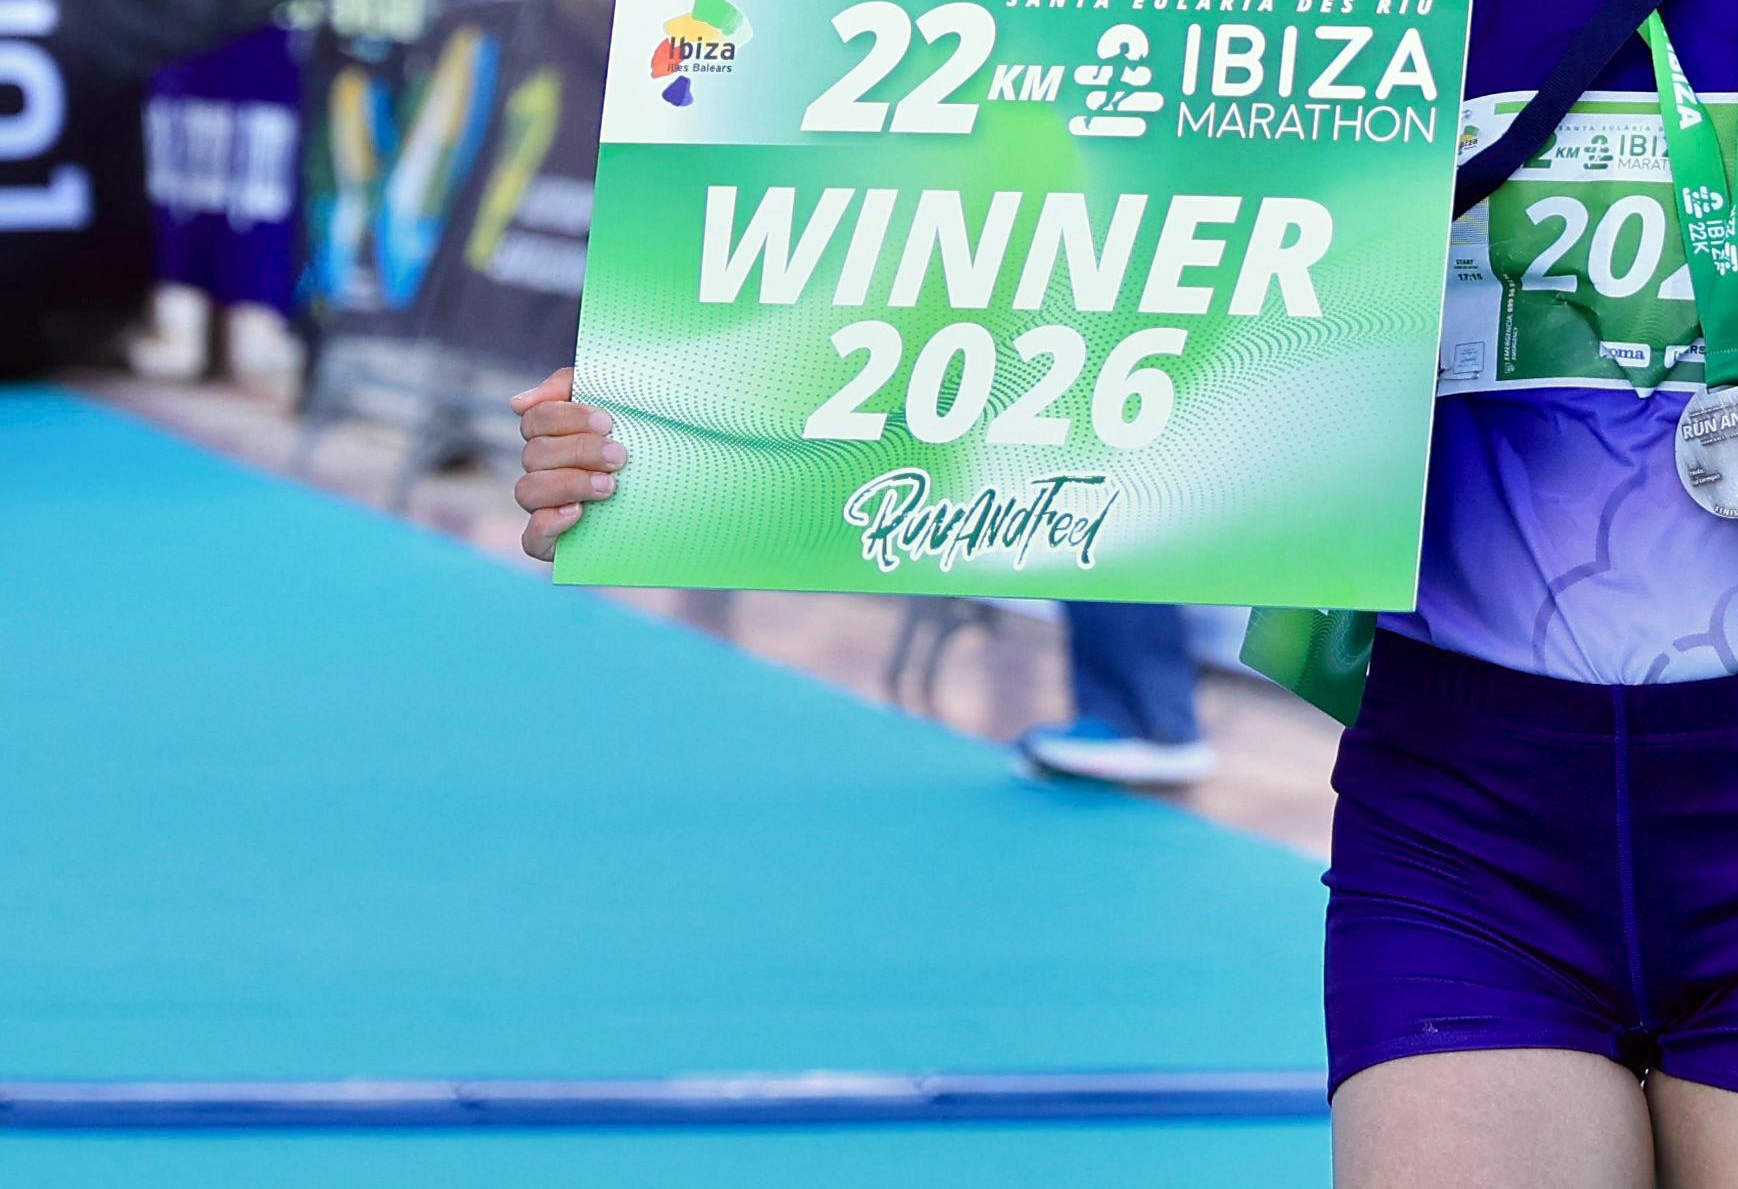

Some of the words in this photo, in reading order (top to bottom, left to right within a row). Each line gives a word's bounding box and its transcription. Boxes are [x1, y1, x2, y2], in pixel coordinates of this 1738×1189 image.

[669, 36, 735, 60] Ibiza
[693, 63, 732, 73] Balears
[800, 1, 997, 135] 22
[987, 64, 1064, 101] KM
[1181, 23, 1437, 101] IBIZA
[1177, 102, 1437, 143] MARATHON
[1555, 146, 1581, 159] KM
[1619, 134, 1670, 158] IBI
[1617, 157, 1670, 171] MARAT
[1688, 222, 1709, 254] 22K
[698, 185, 1335, 318] WINNER
[1609, 347, 1646, 361] oma
[802, 320, 1190, 450] 2026
[1682, 418, 1718, 441] RUN
